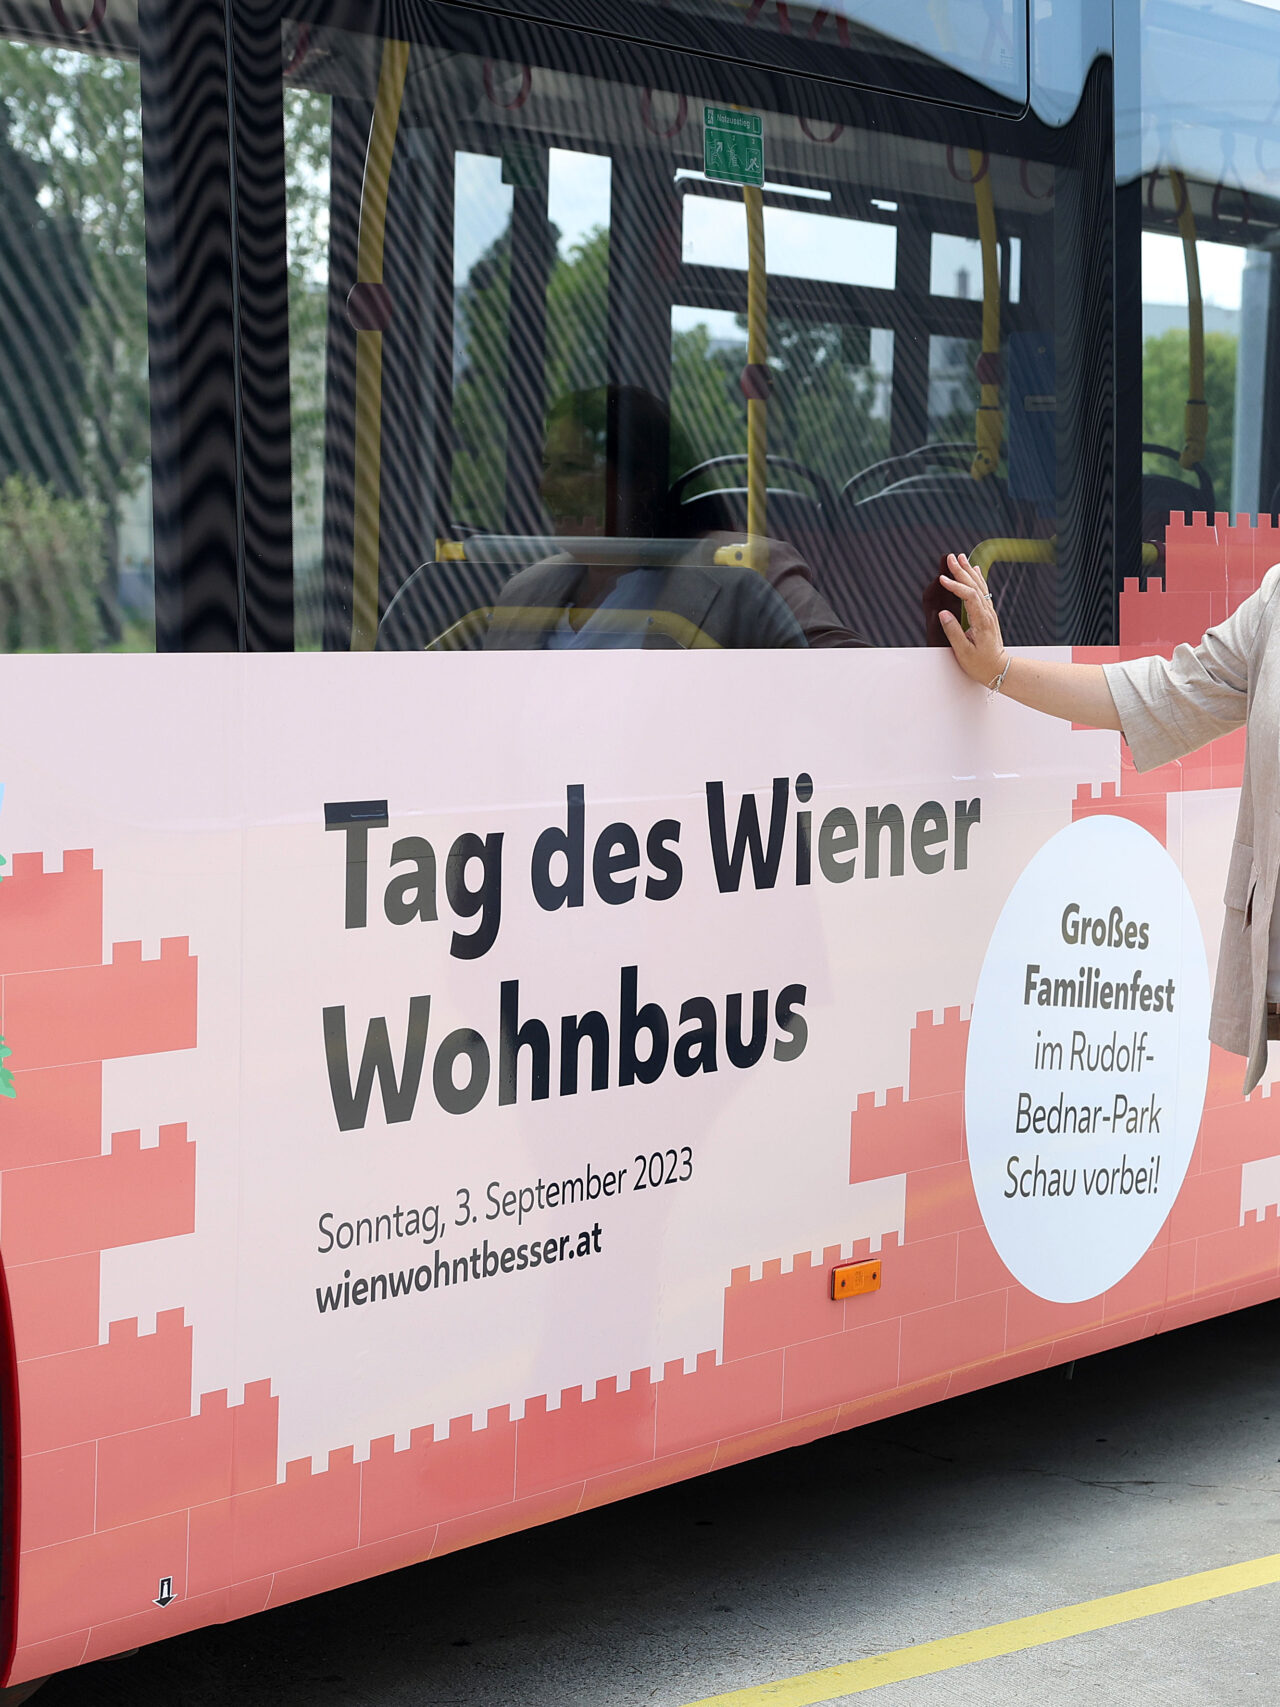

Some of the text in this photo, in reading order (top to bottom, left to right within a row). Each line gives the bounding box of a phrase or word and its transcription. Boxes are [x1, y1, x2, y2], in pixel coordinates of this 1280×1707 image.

[323, 772, 982, 960] Tag des Wiener
[1061, 902, 1150, 950] Großes
[1023, 963, 1176, 1013] Familienfest
[322, 964, 809, 1132] Wohnbaus
[1034, 1030, 1155, 1073] im Rudolf-
[1015, 1091, 1163, 1134] Bednar-Park
[317, 1146, 694, 1254] Sonntag, 3. September 2023
[1003, 1153, 1161, 1199] Schau vorbei!
[315, 1222, 602, 1314] wienwohntbesser.at
